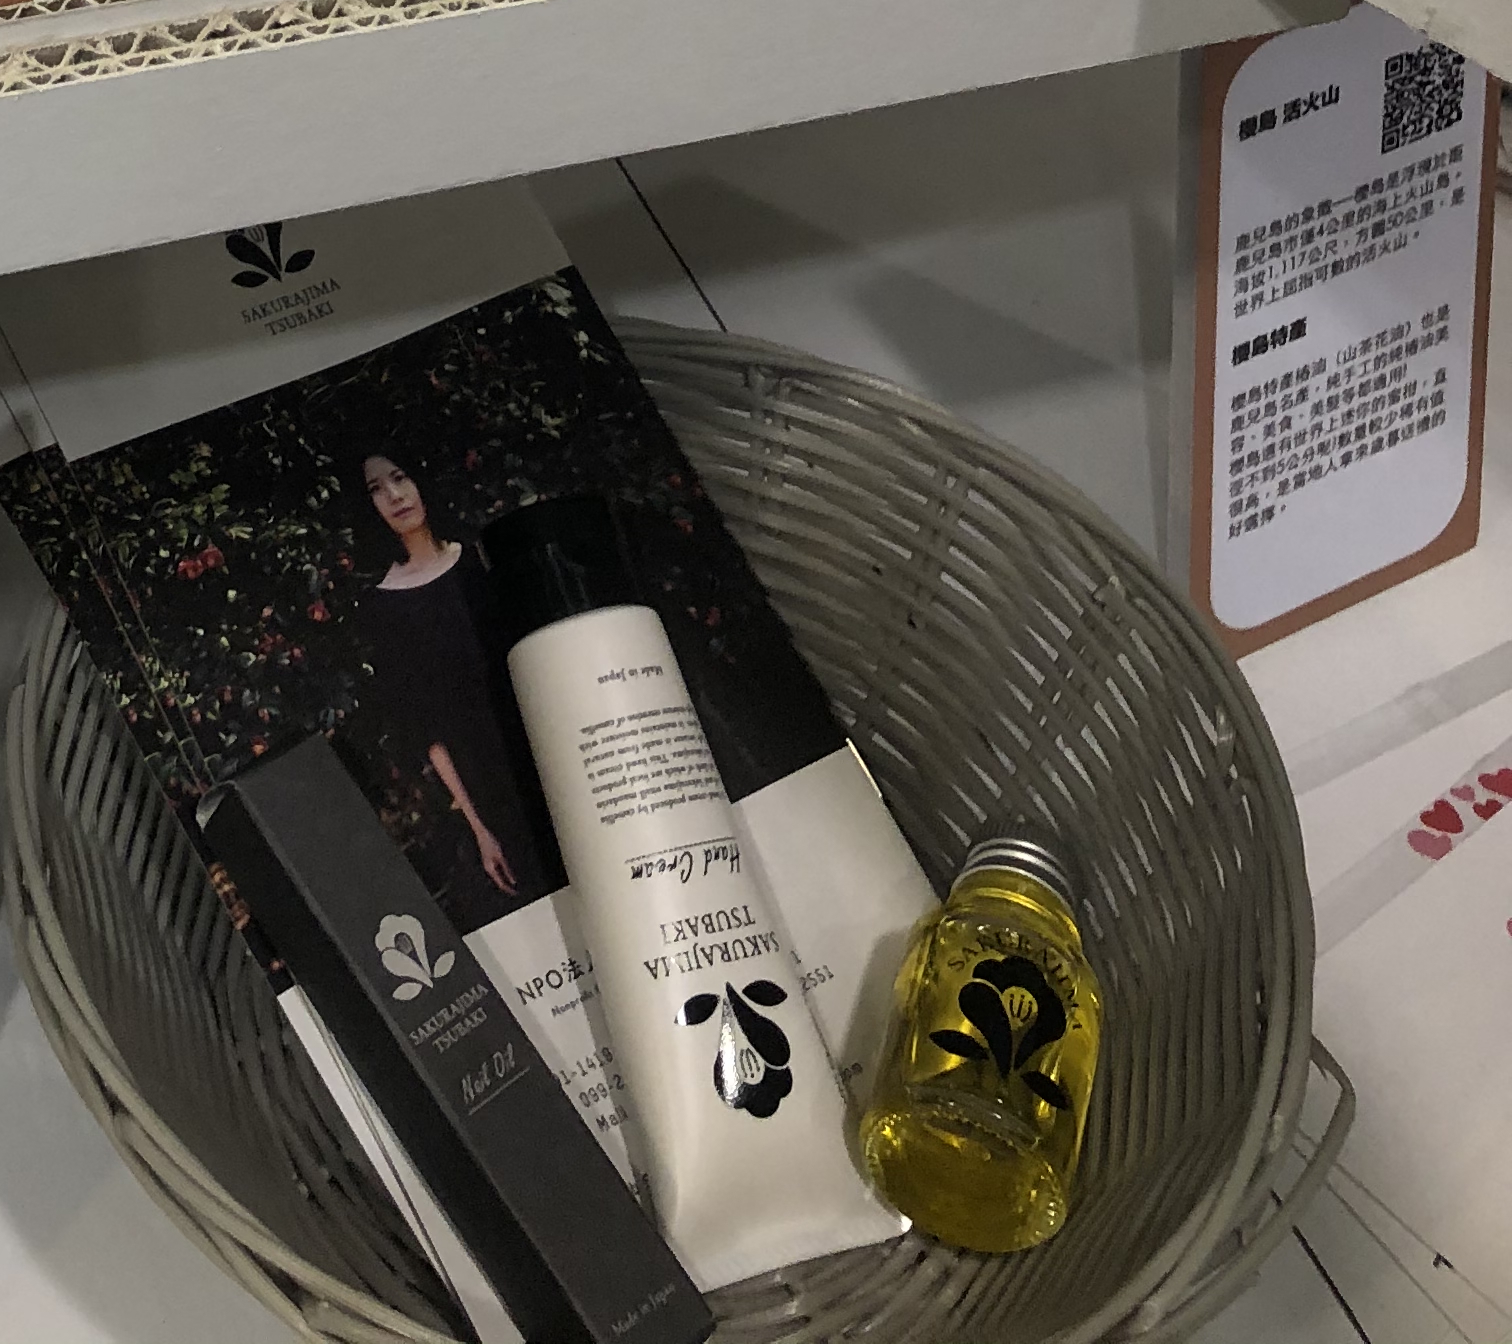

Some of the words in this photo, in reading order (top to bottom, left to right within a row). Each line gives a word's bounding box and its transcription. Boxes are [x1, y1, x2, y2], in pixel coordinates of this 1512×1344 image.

[241, 278, 341, 325] SAKURAJIMA
[264, 301, 334, 336] TSUBAKI
[631, 851, 694, 883] Cream
[702, 842, 741, 876] Hand
[660, 905, 756, 946] TSUBAKI
[410, 981, 489, 1047] SAKURAJIMA
[430, 1006, 489, 1055] TSUBAKI
